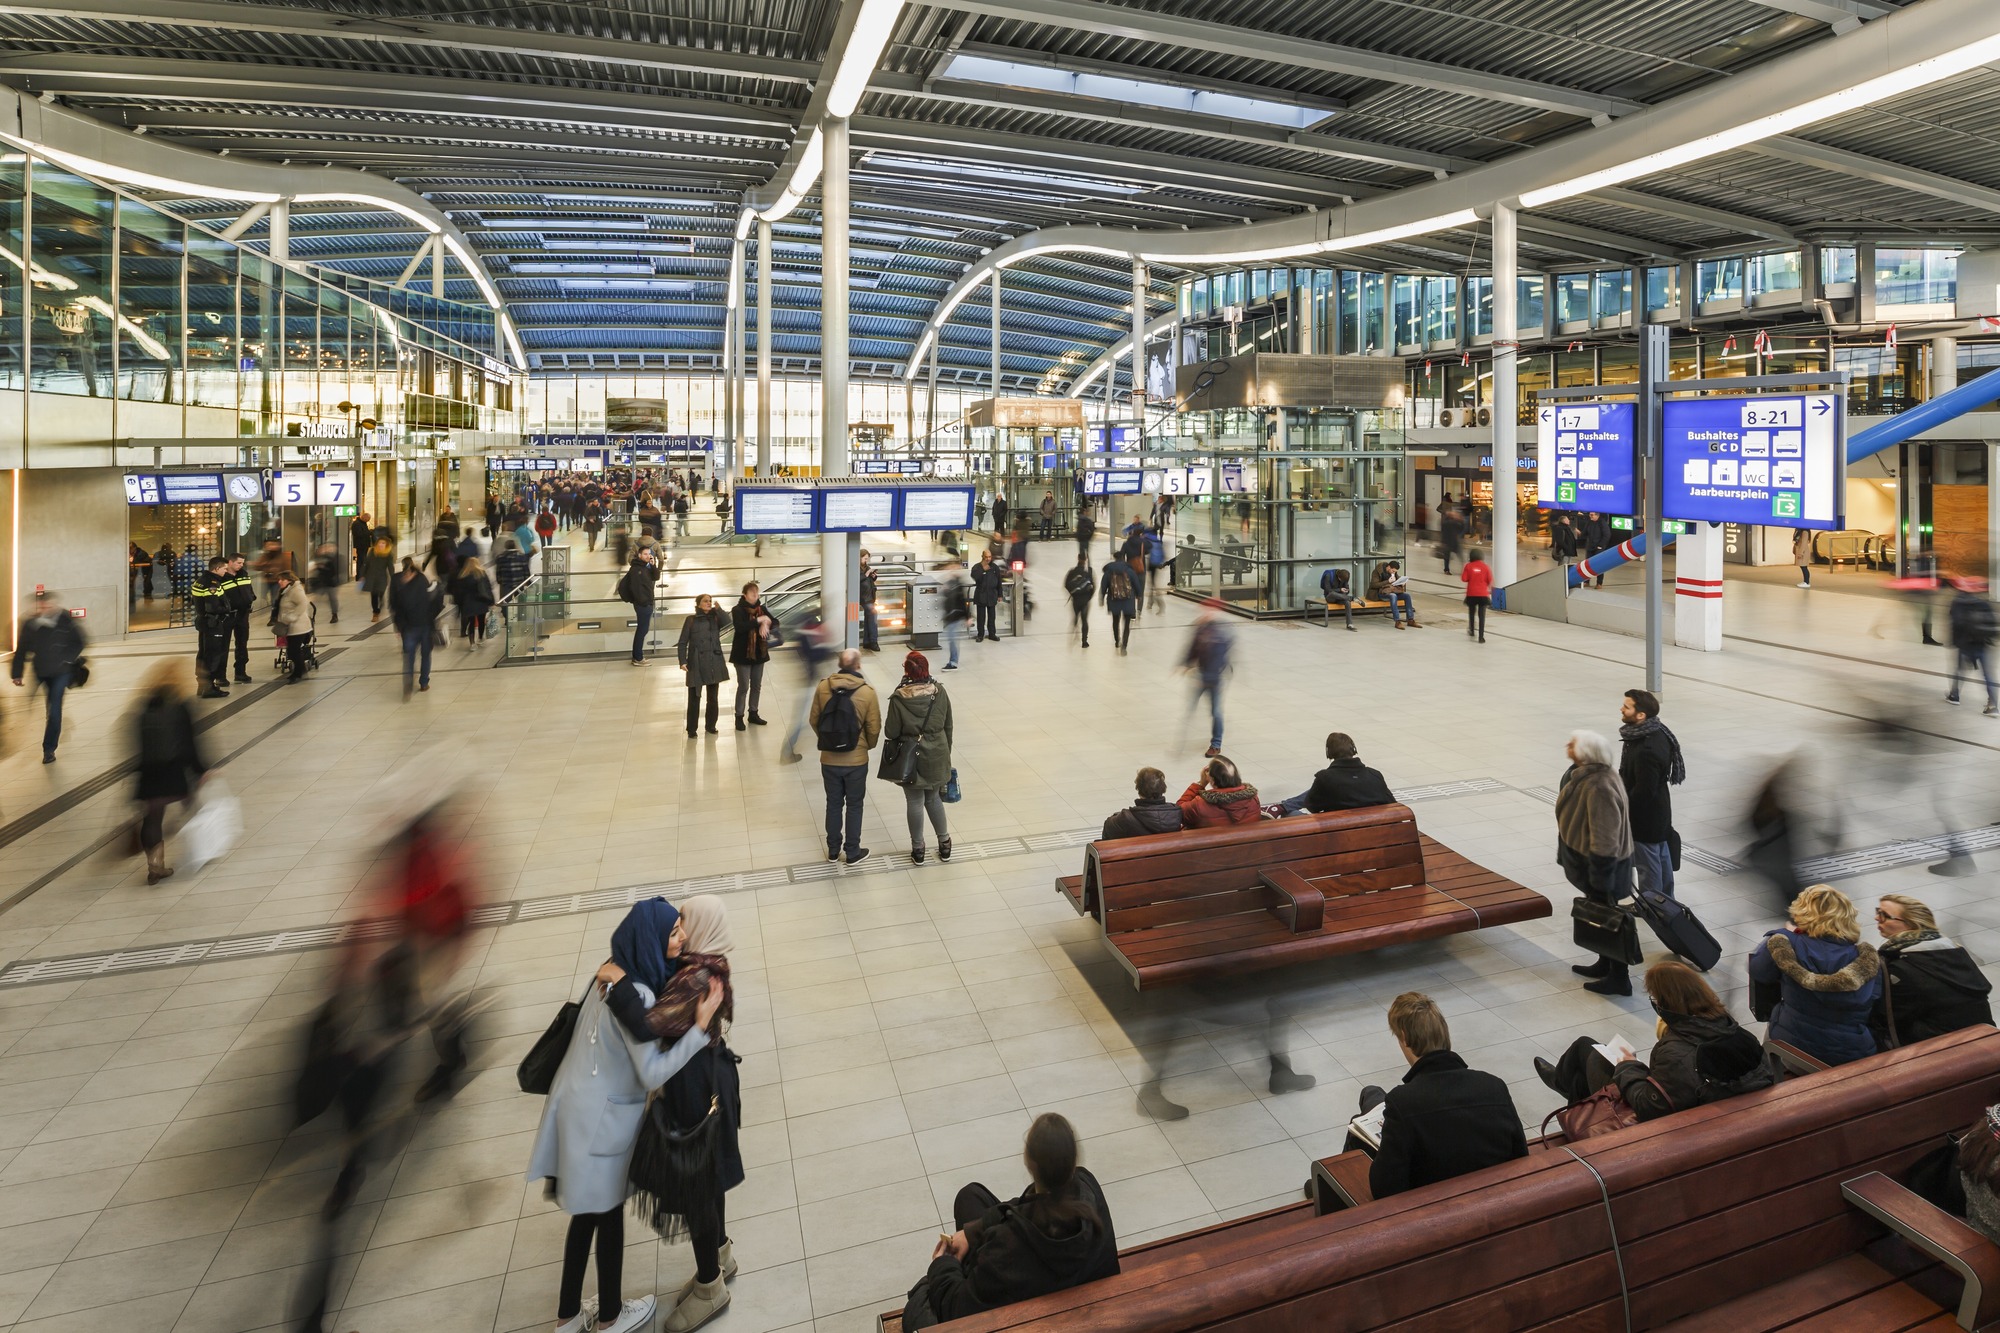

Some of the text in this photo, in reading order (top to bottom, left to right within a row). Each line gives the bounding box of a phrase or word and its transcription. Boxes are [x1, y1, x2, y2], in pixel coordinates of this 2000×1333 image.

[1561, 416, 1581, 428] 1-7
[300, 422, 348, 438] STARBUCKS
[1688, 430, 1739, 440] Bushaltes
[1578, 432, 1619, 440] Bushaltes
[552, 437, 687, 447] Centrum Hoog Catharijne
[1578, 443, 1593, 451] A B
[1710, 443, 1739, 452] G C D
[1196, 477, 1205, 492] 7
[1744, 474, 1766, 484] WC
[1171, 478, 1179, 492] 5
[1578, 482, 1614, 491] Centrum
[287, 484, 301, 503] 5
[330, 483, 345, 502] 7
[1689, 486, 1769, 500] Jaarbeursplein
